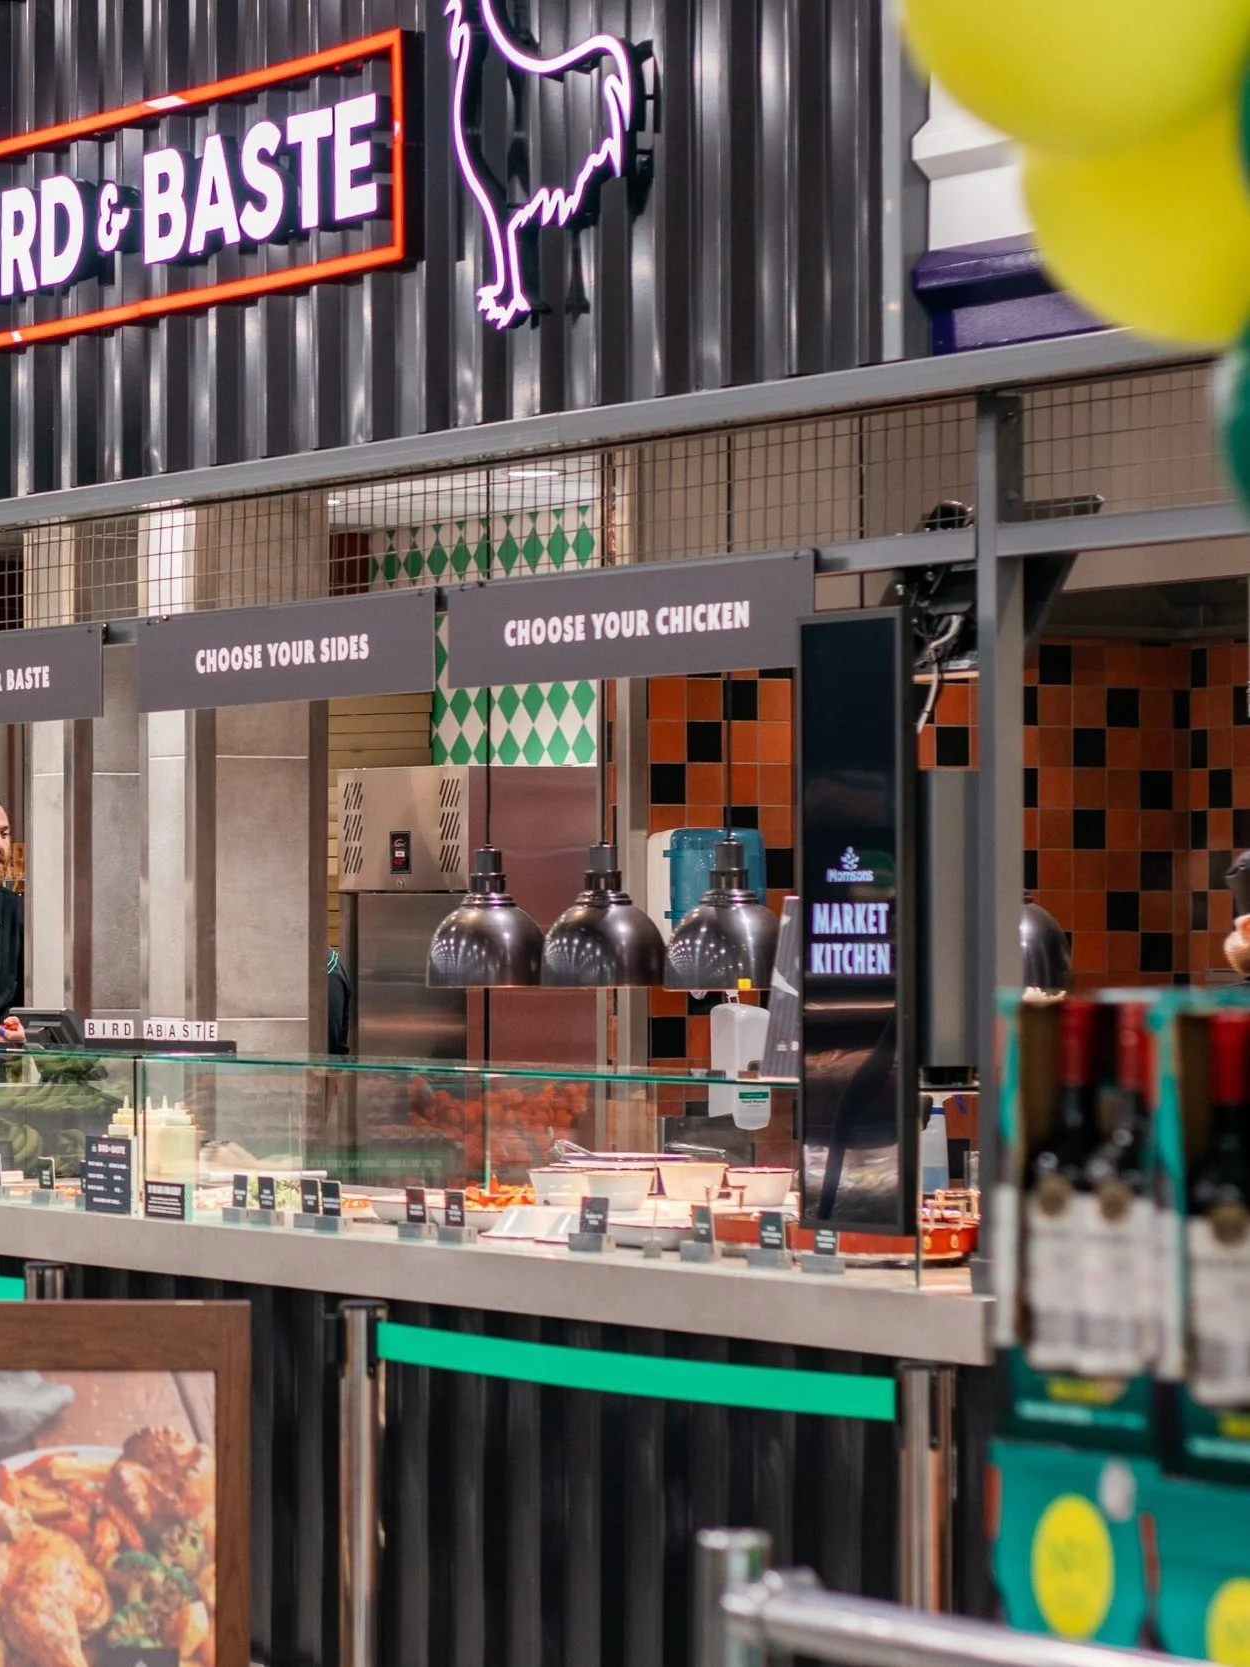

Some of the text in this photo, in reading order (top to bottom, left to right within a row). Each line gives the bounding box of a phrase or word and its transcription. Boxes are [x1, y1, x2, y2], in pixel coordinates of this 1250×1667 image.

[96, 181, 131, 253] &
[143, 92, 378, 266] BASTE
[504, 600, 750, 647] CHOOSE YOUR CHICKEN
[196, 633, 369, 674] CHOOSE YOUR SIDES
[6, 665, 50, 691] BASTE
[826, 867, 874, 882] Morrisons
[812, 902, 890, 934] MARKET
[811, 942, 890, 975] KITCHEN
[88, 1022, 132, 1036] BIRD
